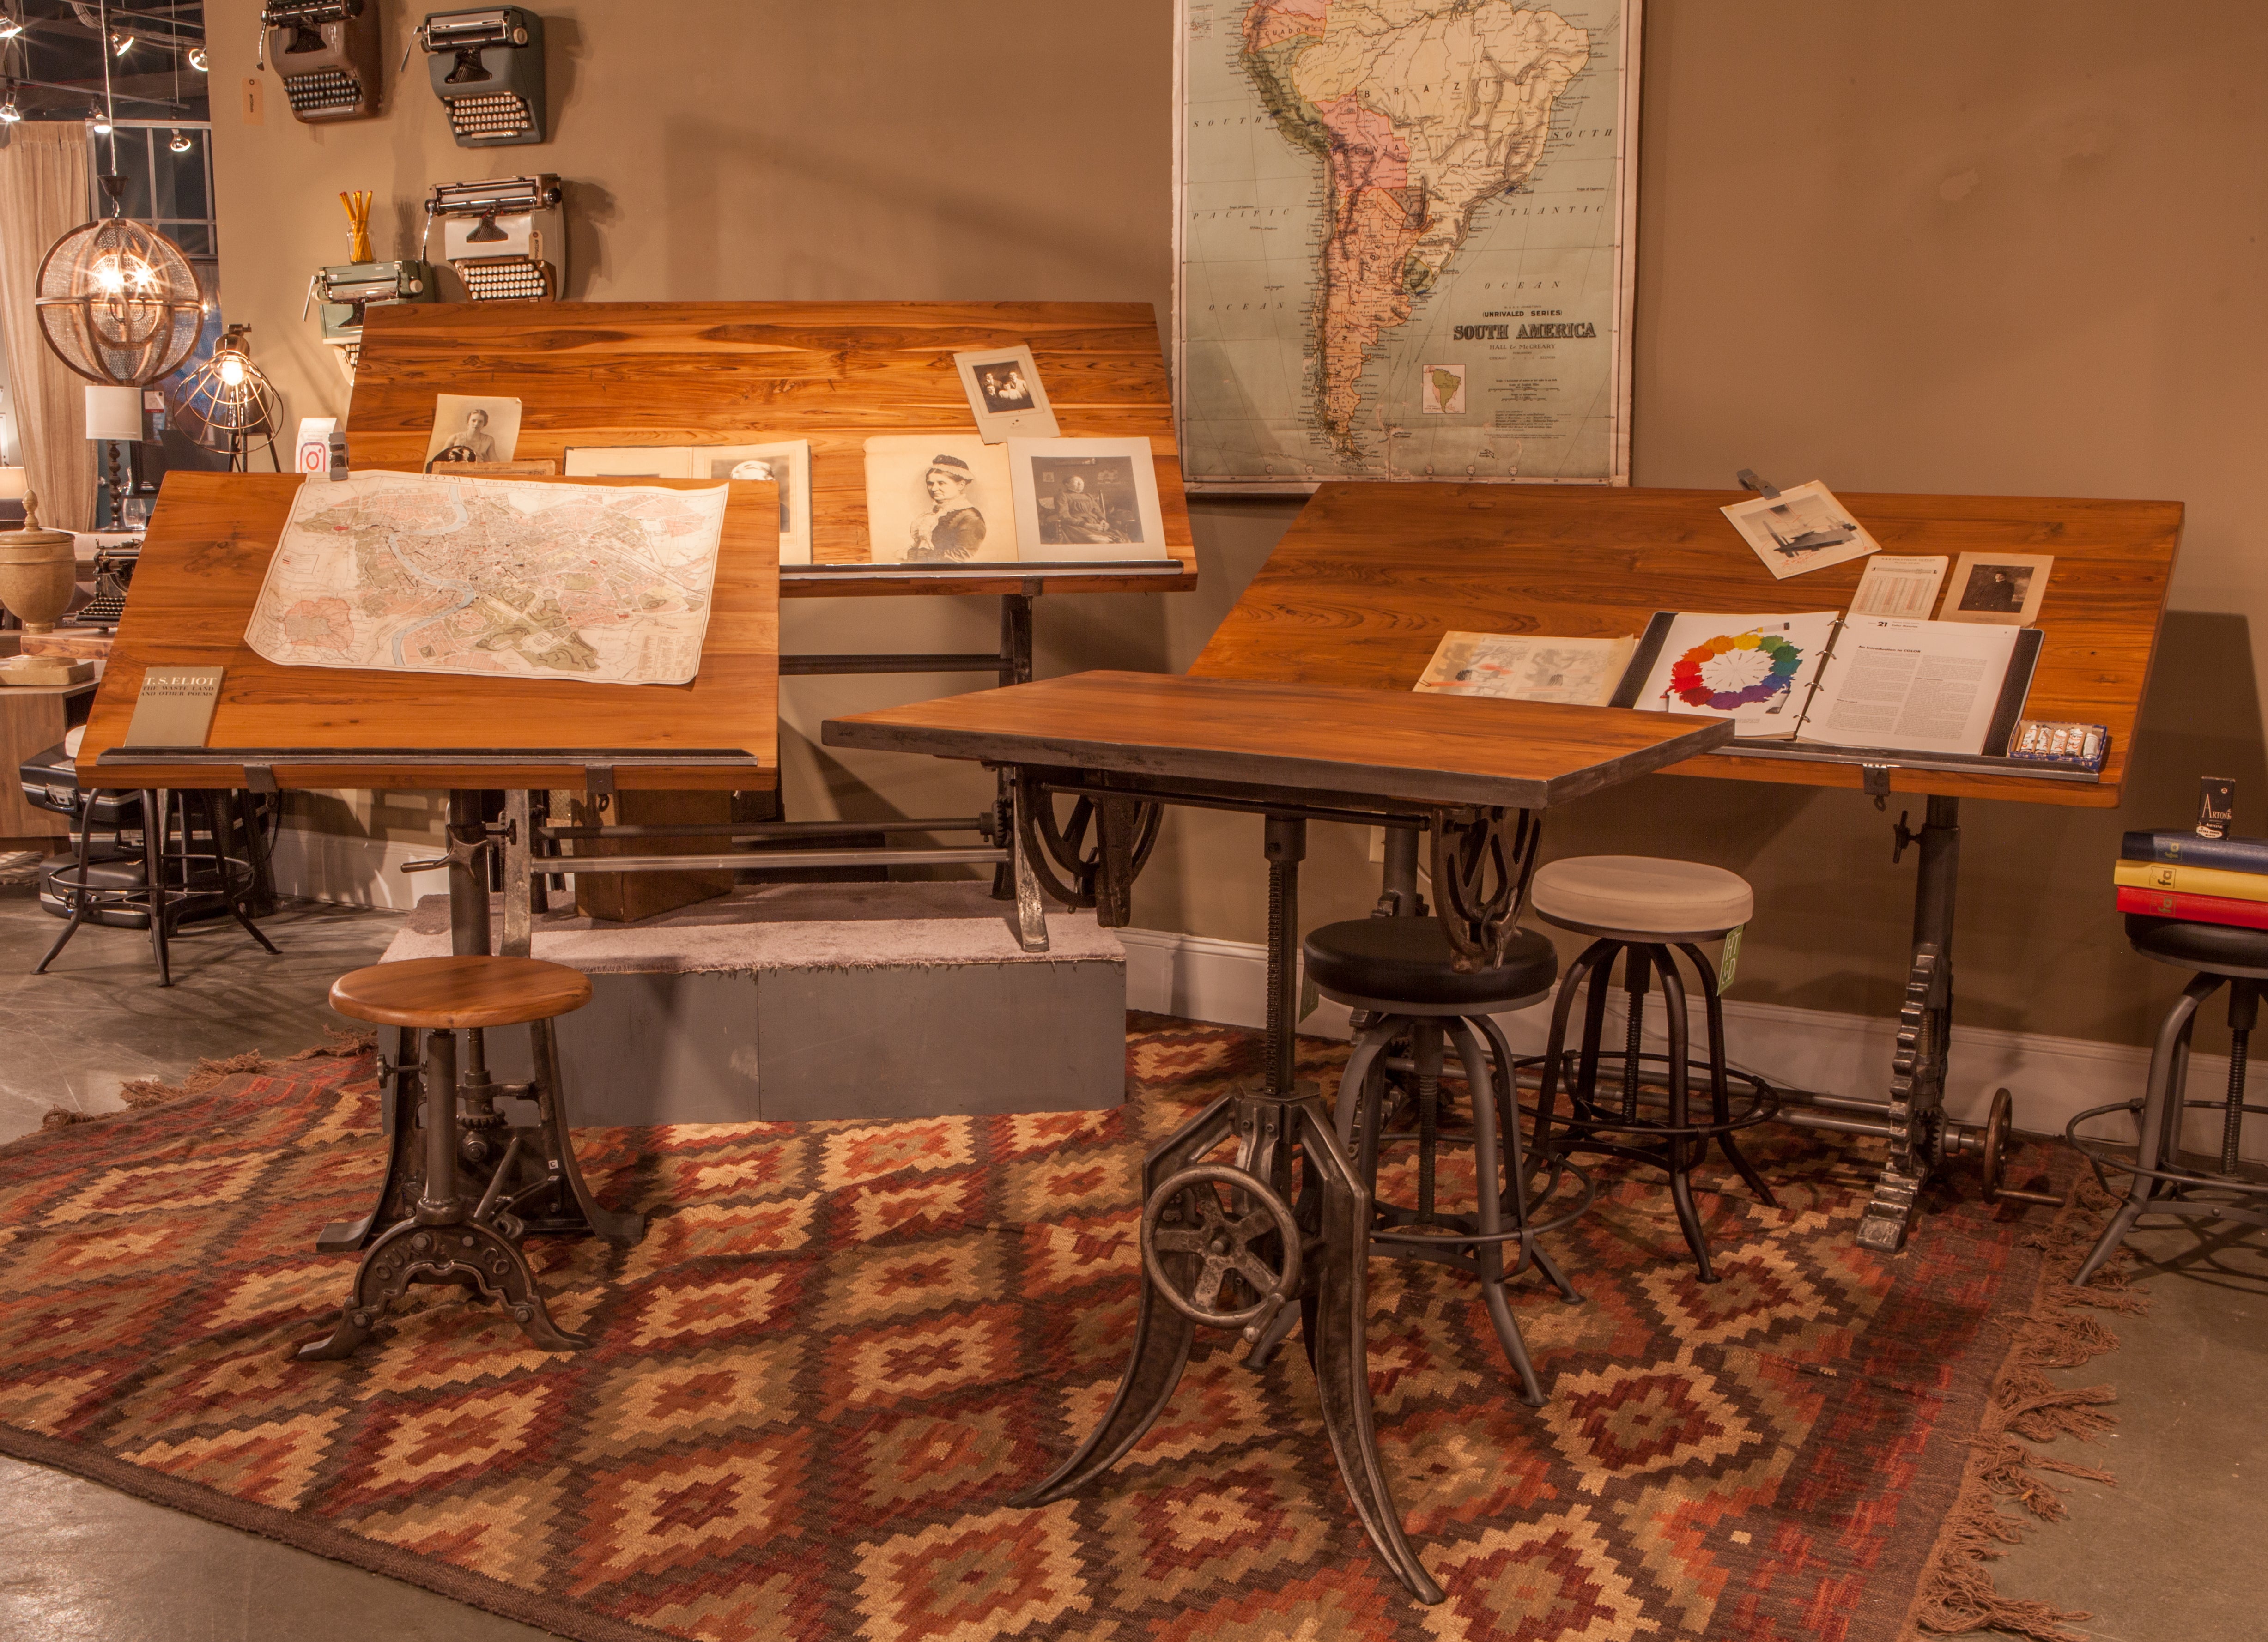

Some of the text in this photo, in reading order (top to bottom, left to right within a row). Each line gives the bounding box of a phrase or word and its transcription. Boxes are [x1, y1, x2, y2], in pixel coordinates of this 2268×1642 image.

[1364, 78, 1522, 98] BRAZIL
[1193, 116, 1261, 127] SOUTH
[1552, 129, 1613, 139] SOUTH
[1333, 145, 1400, 155] BOLIVIA
[1193, 208, 1289, 220] PACIFIC
[1495, 205, 1604, 217] ATLANTIC
[1485, 281, 1560, 290] OCEAN
[1209, 302, 1284, 311] OCEAN
[1453, 322, 1597, 340] SOUTH AMERICA
[422, 474, 475, 484] ROMA
[145, 676, 217, 685] T. S. ELIOT
[2164, 842, 2180, 859] fa
[2157, 870, 2173, 886] fa
[2158, 897, 2173, 913] fa
